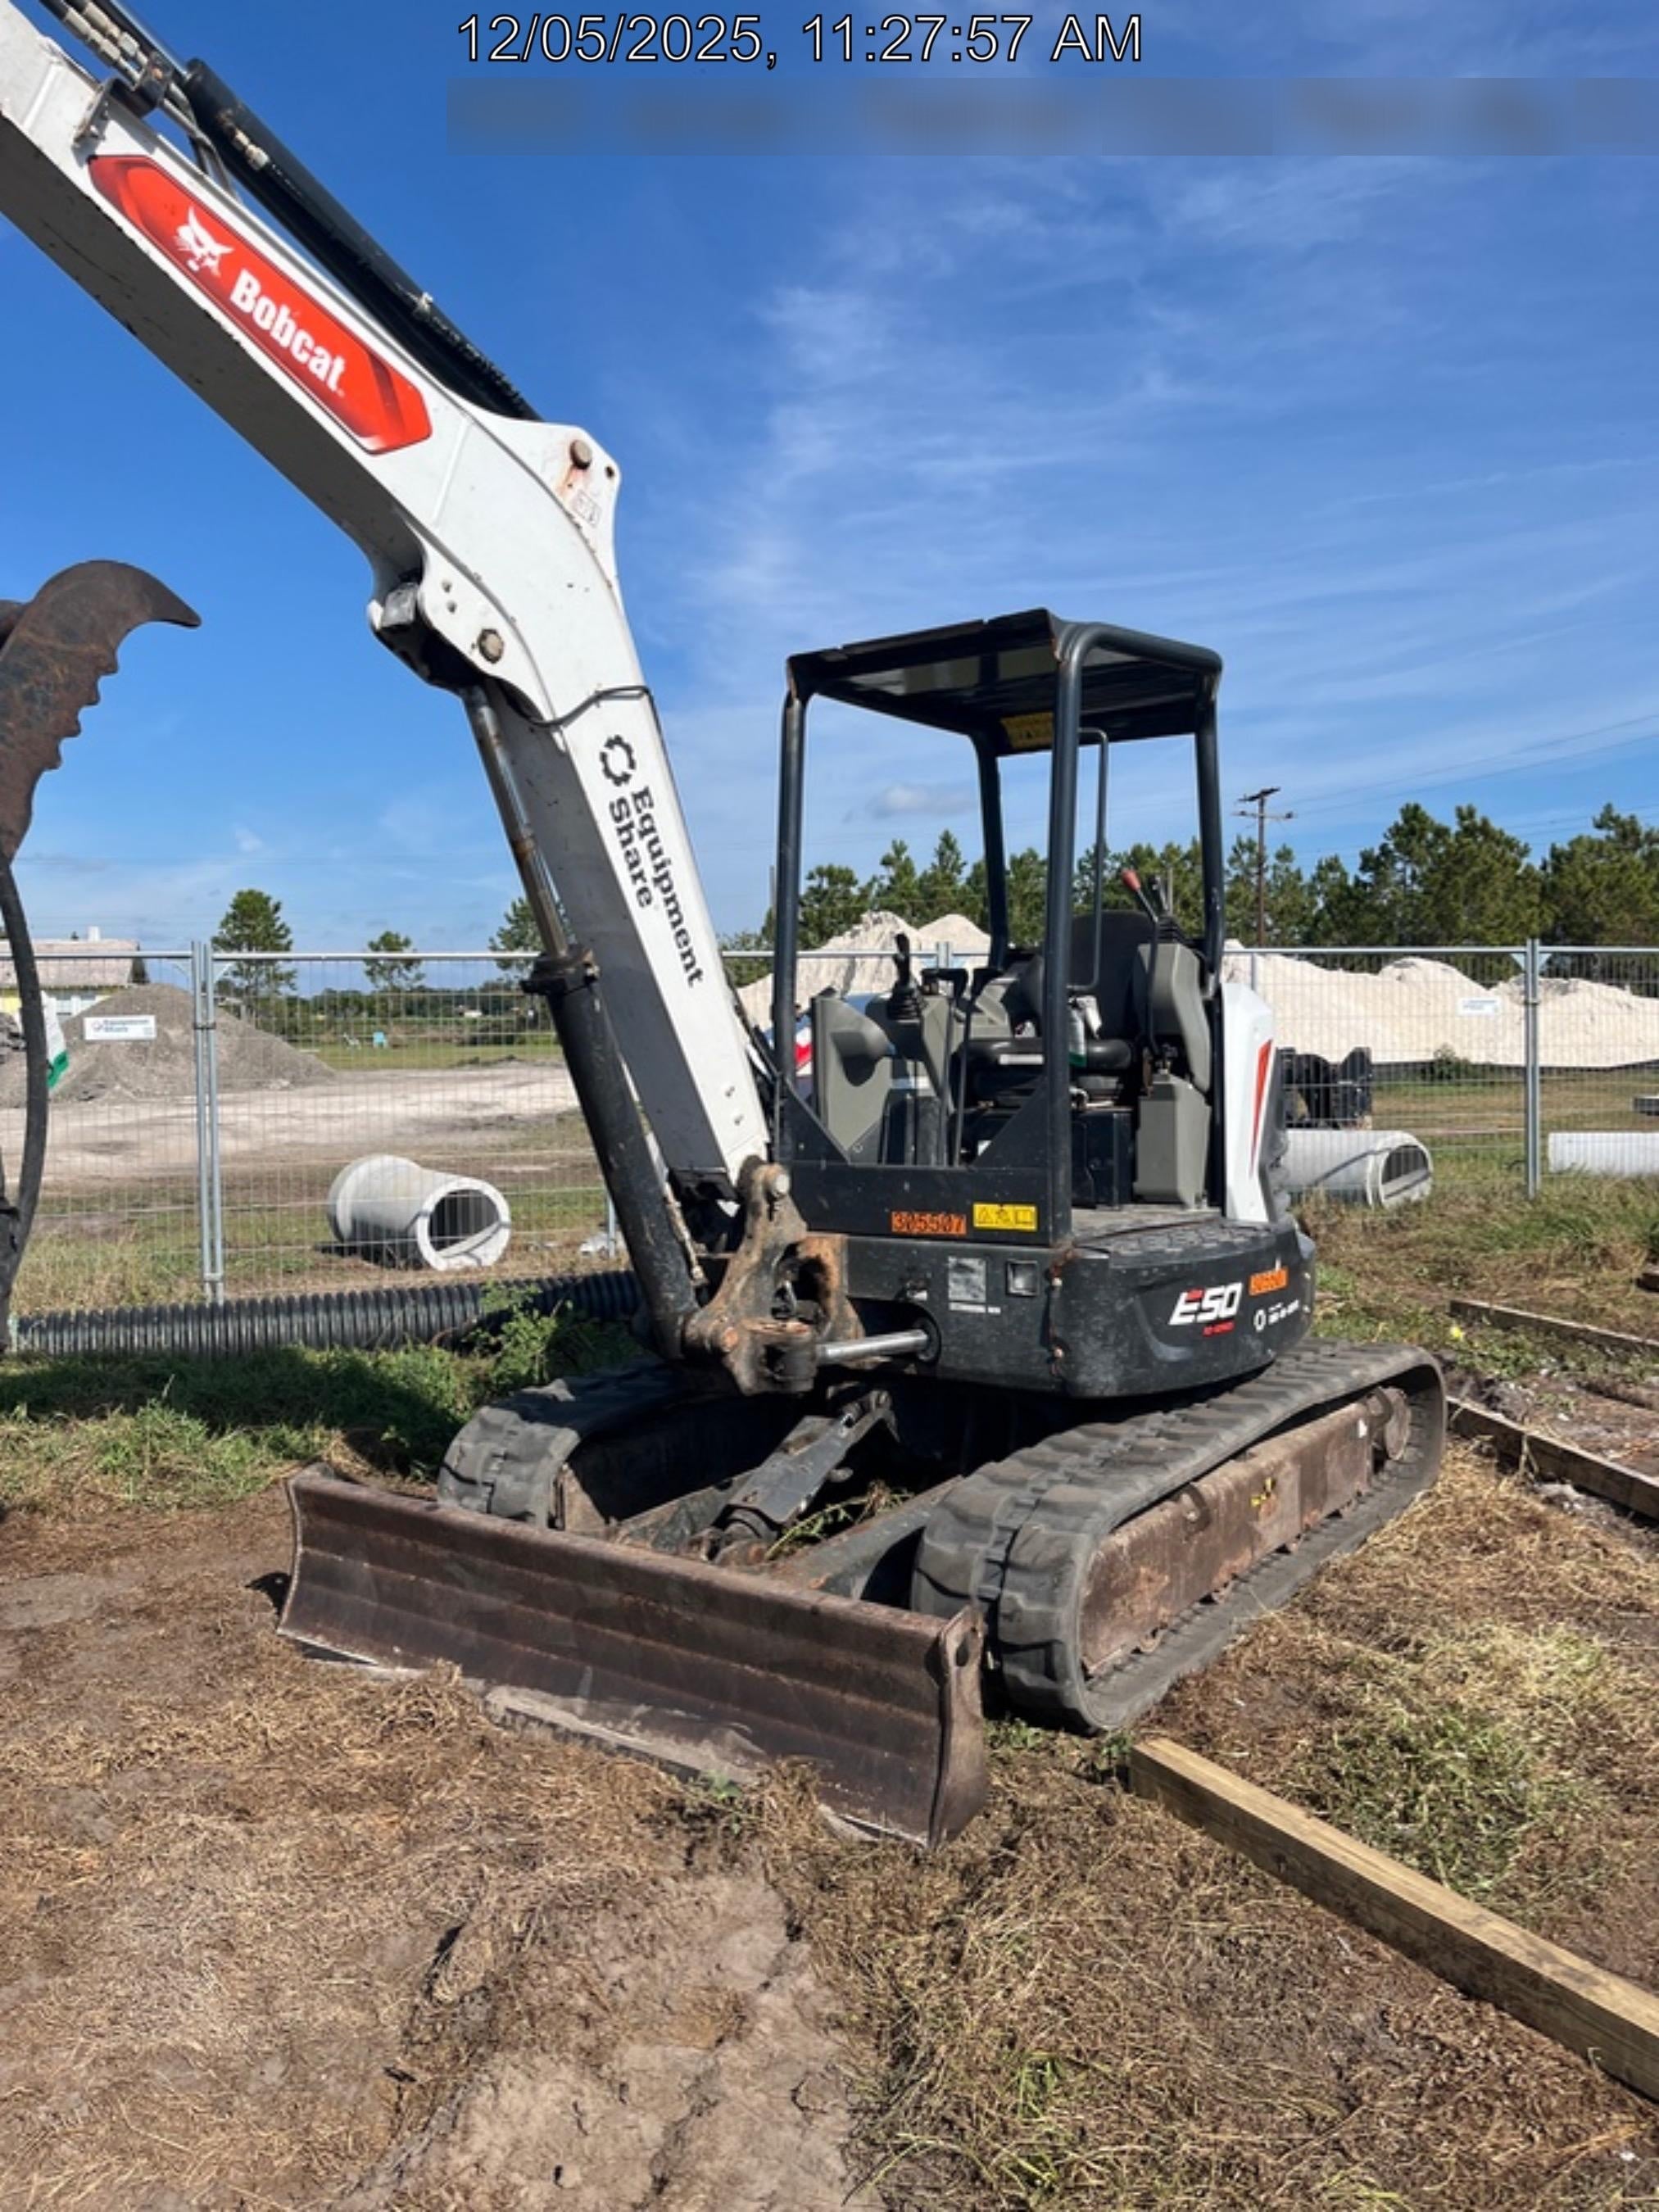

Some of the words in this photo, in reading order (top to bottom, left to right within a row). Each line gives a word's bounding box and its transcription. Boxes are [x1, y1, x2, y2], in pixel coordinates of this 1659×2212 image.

[229, 269, 345, 392] Bobcat
[610, 799, 652, 909] Share
[632, 785, 703, 987] Equipment
[1168, 1282, 1243, 1326] E50
